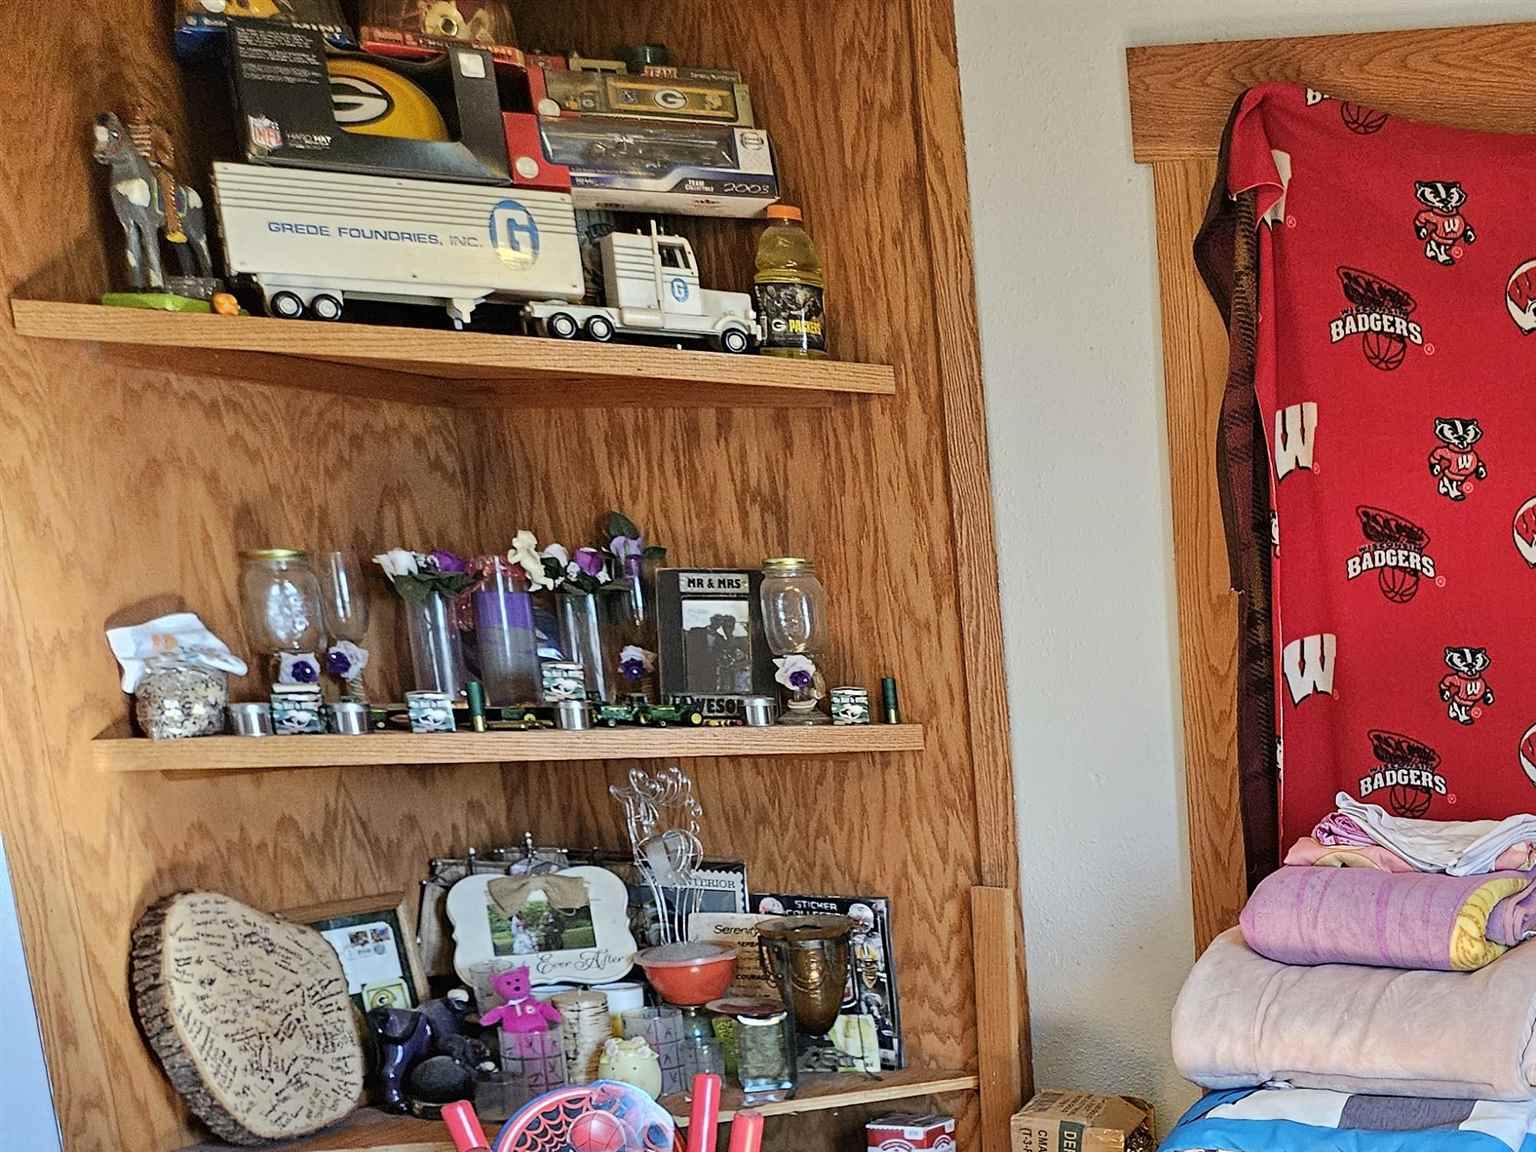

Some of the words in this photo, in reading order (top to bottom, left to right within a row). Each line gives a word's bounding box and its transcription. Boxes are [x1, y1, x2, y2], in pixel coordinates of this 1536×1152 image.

[722, 182, 770, 194] 2003
[267, 221, 331, 237] GREDE
[337, 227, 443, 246] FOUNDRIES,
[448, 235, 484, 249] INC.
[1330, 313, 1423, 345] BADGERS
[1275, 401, 1318, 481] W
[1346, 549, 1436, 579] BADGERS
[687, 578, 704, 589] MR
[706, 579, 715, 589] &
[717, 578, 741, 589] MRS
[1284, 633, 1337, 705] W
[1359, 768, 1448, 798] BADGERS
[793, 900, 838, 912] STICKER
[536, 953, 574, 975] Ever
[574, 949, 625, 972] After
